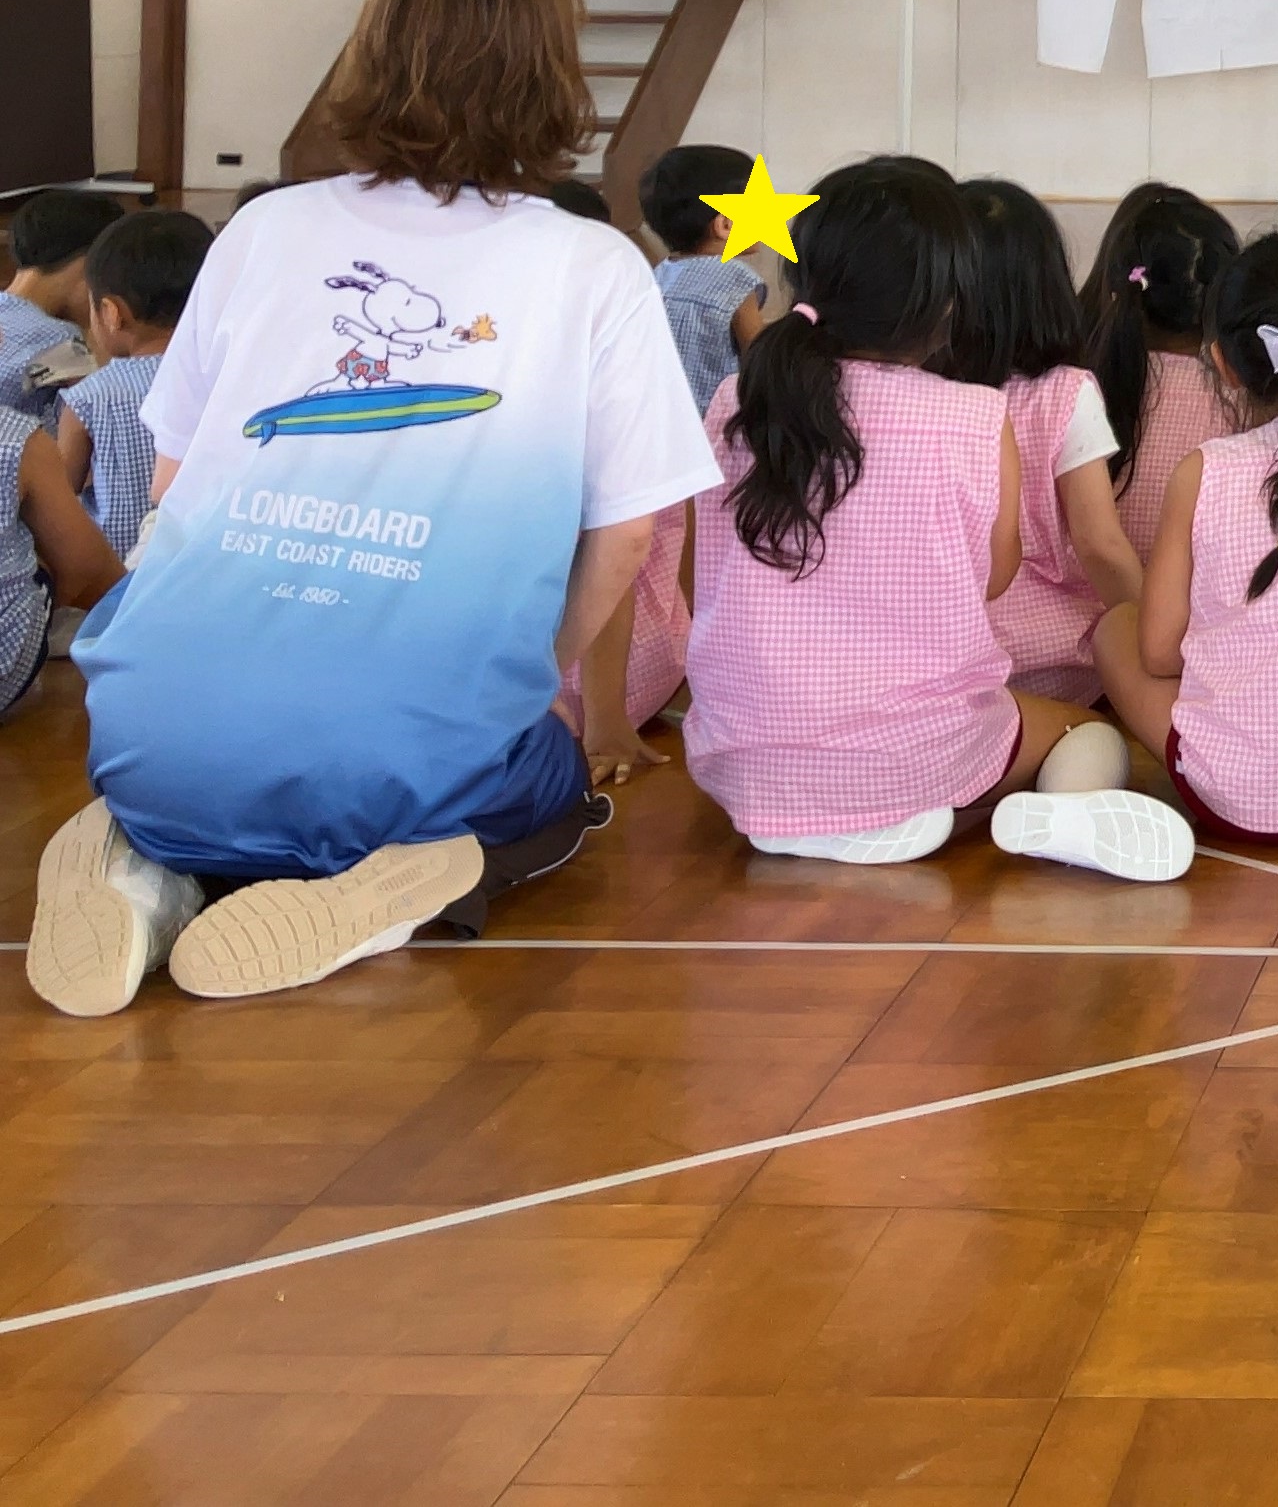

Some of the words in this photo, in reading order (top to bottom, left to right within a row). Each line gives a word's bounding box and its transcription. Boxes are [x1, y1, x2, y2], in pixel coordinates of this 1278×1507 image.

[228, 488, 431, 548] LONGBOARD
[221, 531, 272, 556] EAST
[276, 538, 346, 569] COAST
[347, 550, 423, 582] RIDERS
